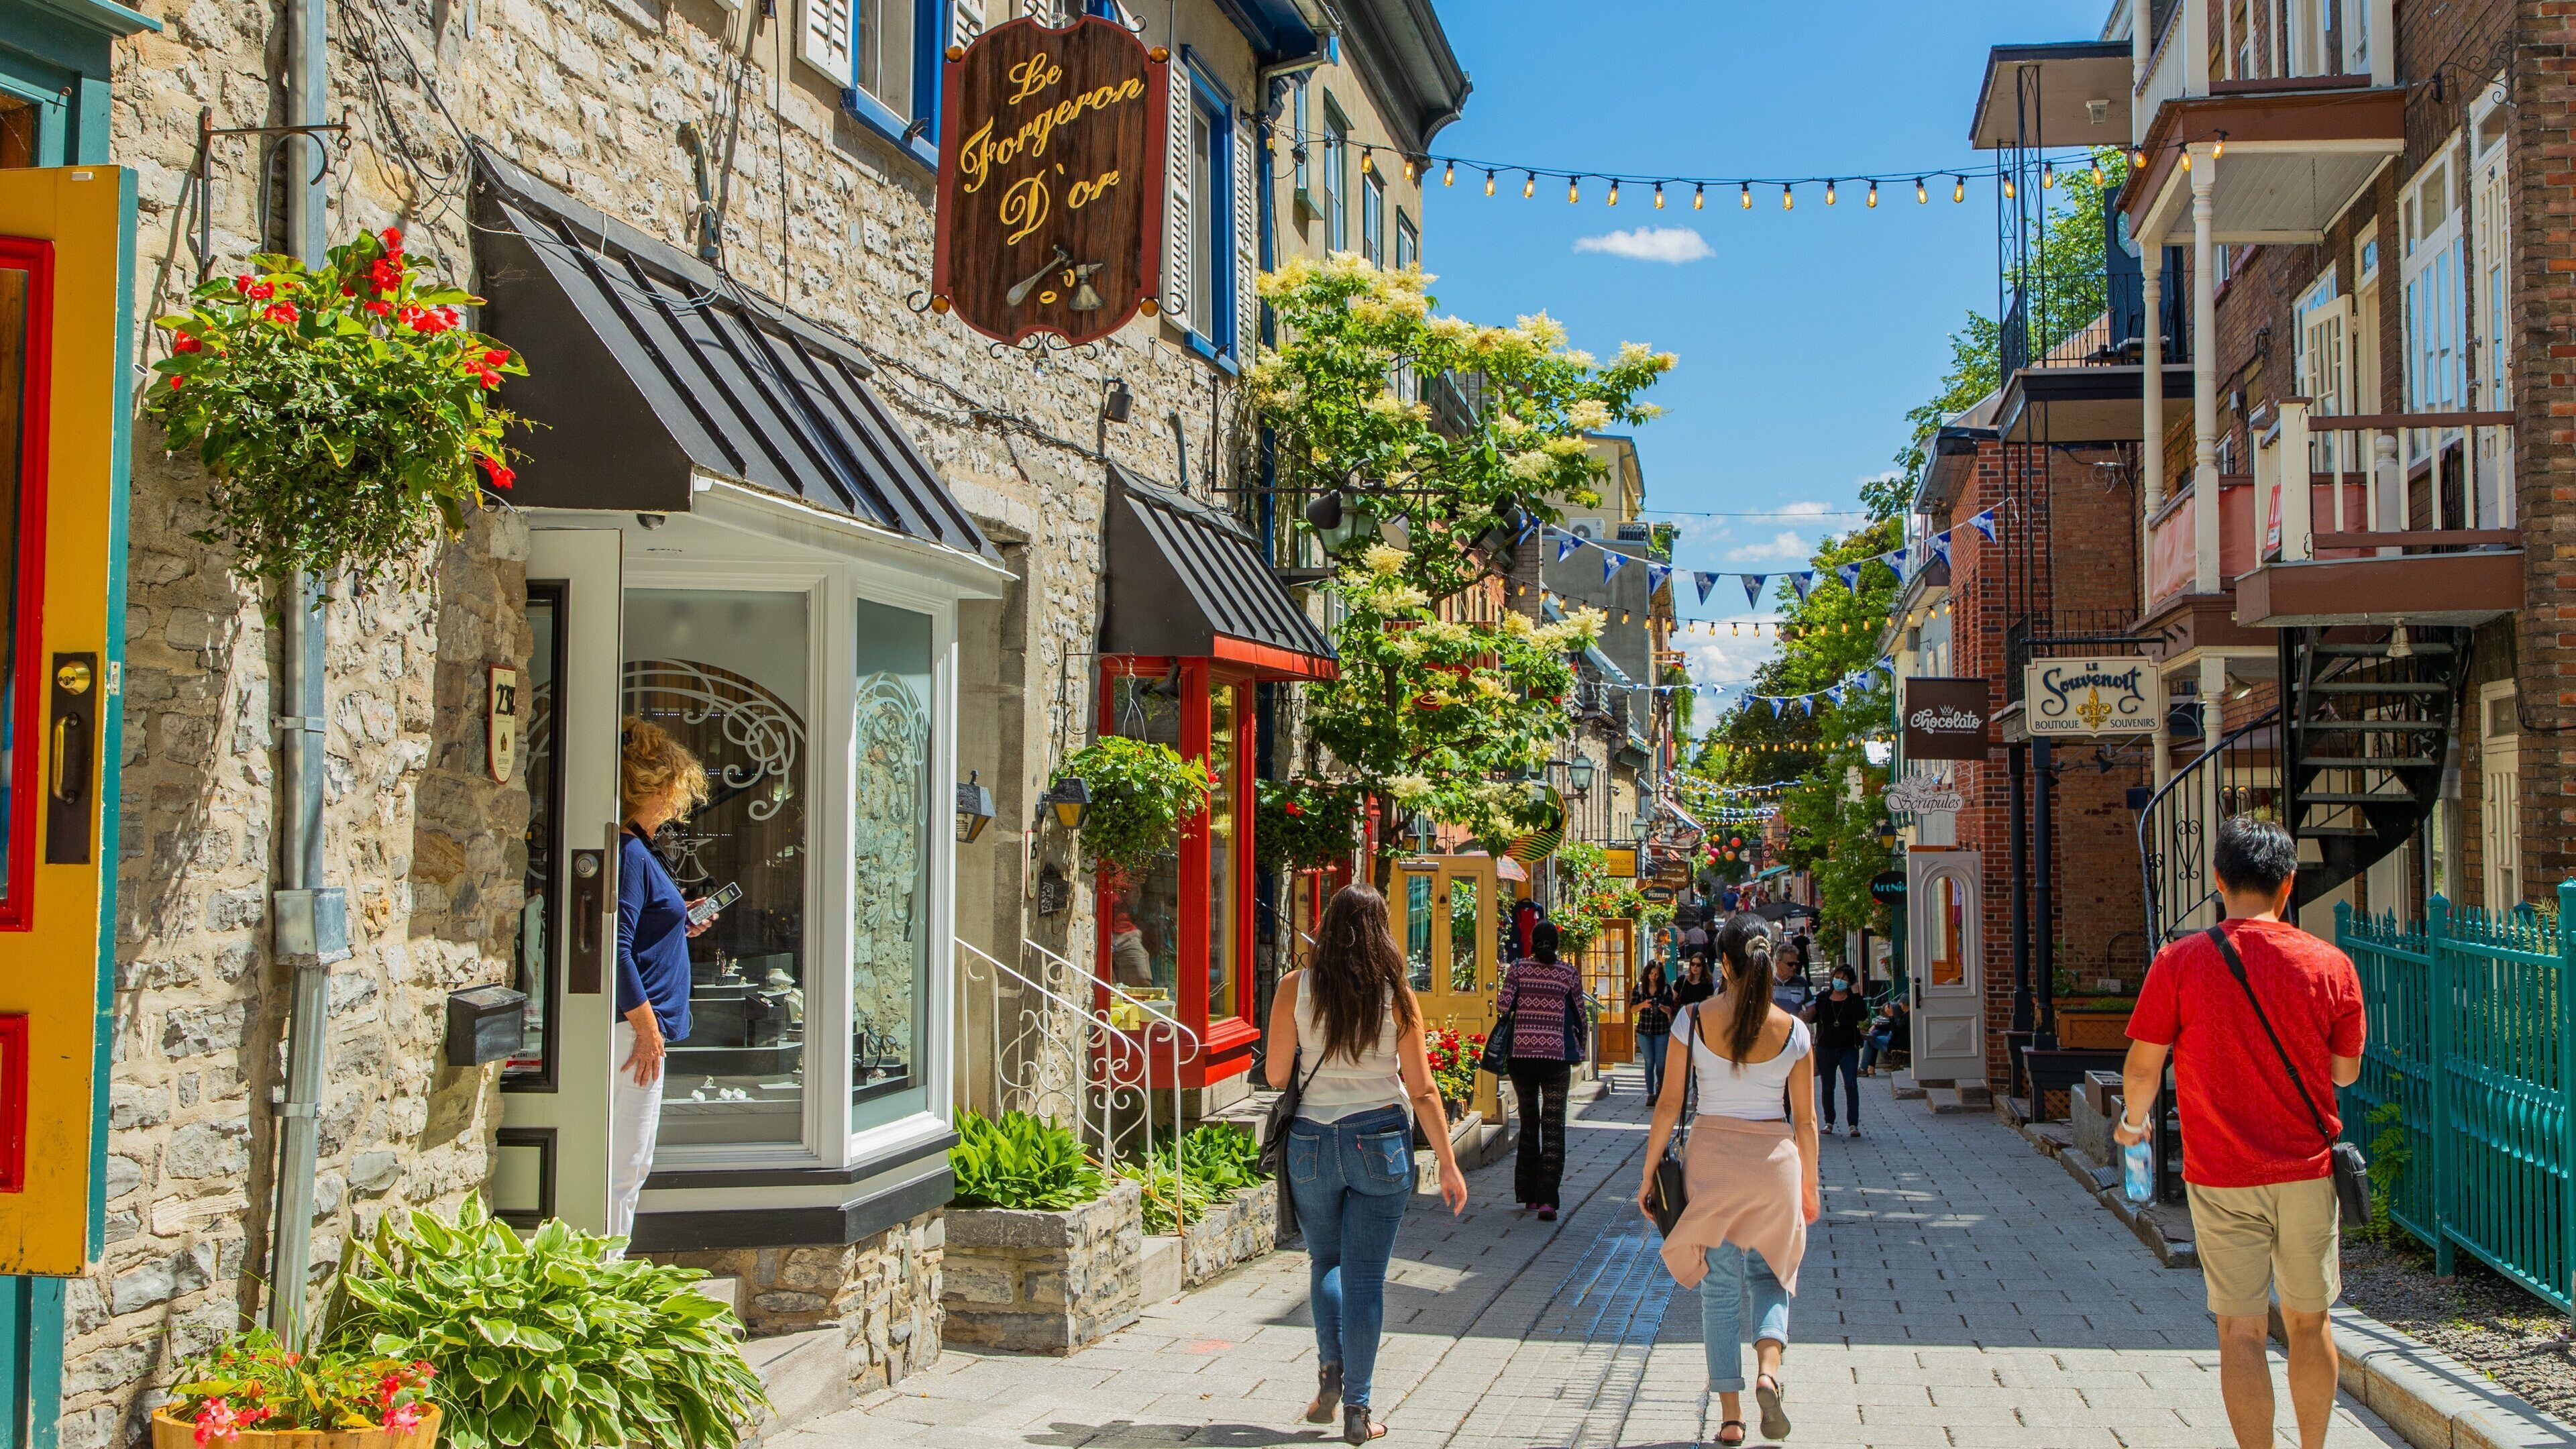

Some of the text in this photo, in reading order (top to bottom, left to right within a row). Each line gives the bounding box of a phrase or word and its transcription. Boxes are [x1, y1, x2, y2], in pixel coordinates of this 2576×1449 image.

[1008, 52, 1063, 105] Le
[960, 77, 1145, 193] Forgeron
[2085, 662, 2098, 672] LE
[1911, 708, 1983, 734] Chocolato
[2035, 718, 2155, 729] BOUTIQUE SOUVENIRS
[1888, 794, 1960, 814] Scrupules
